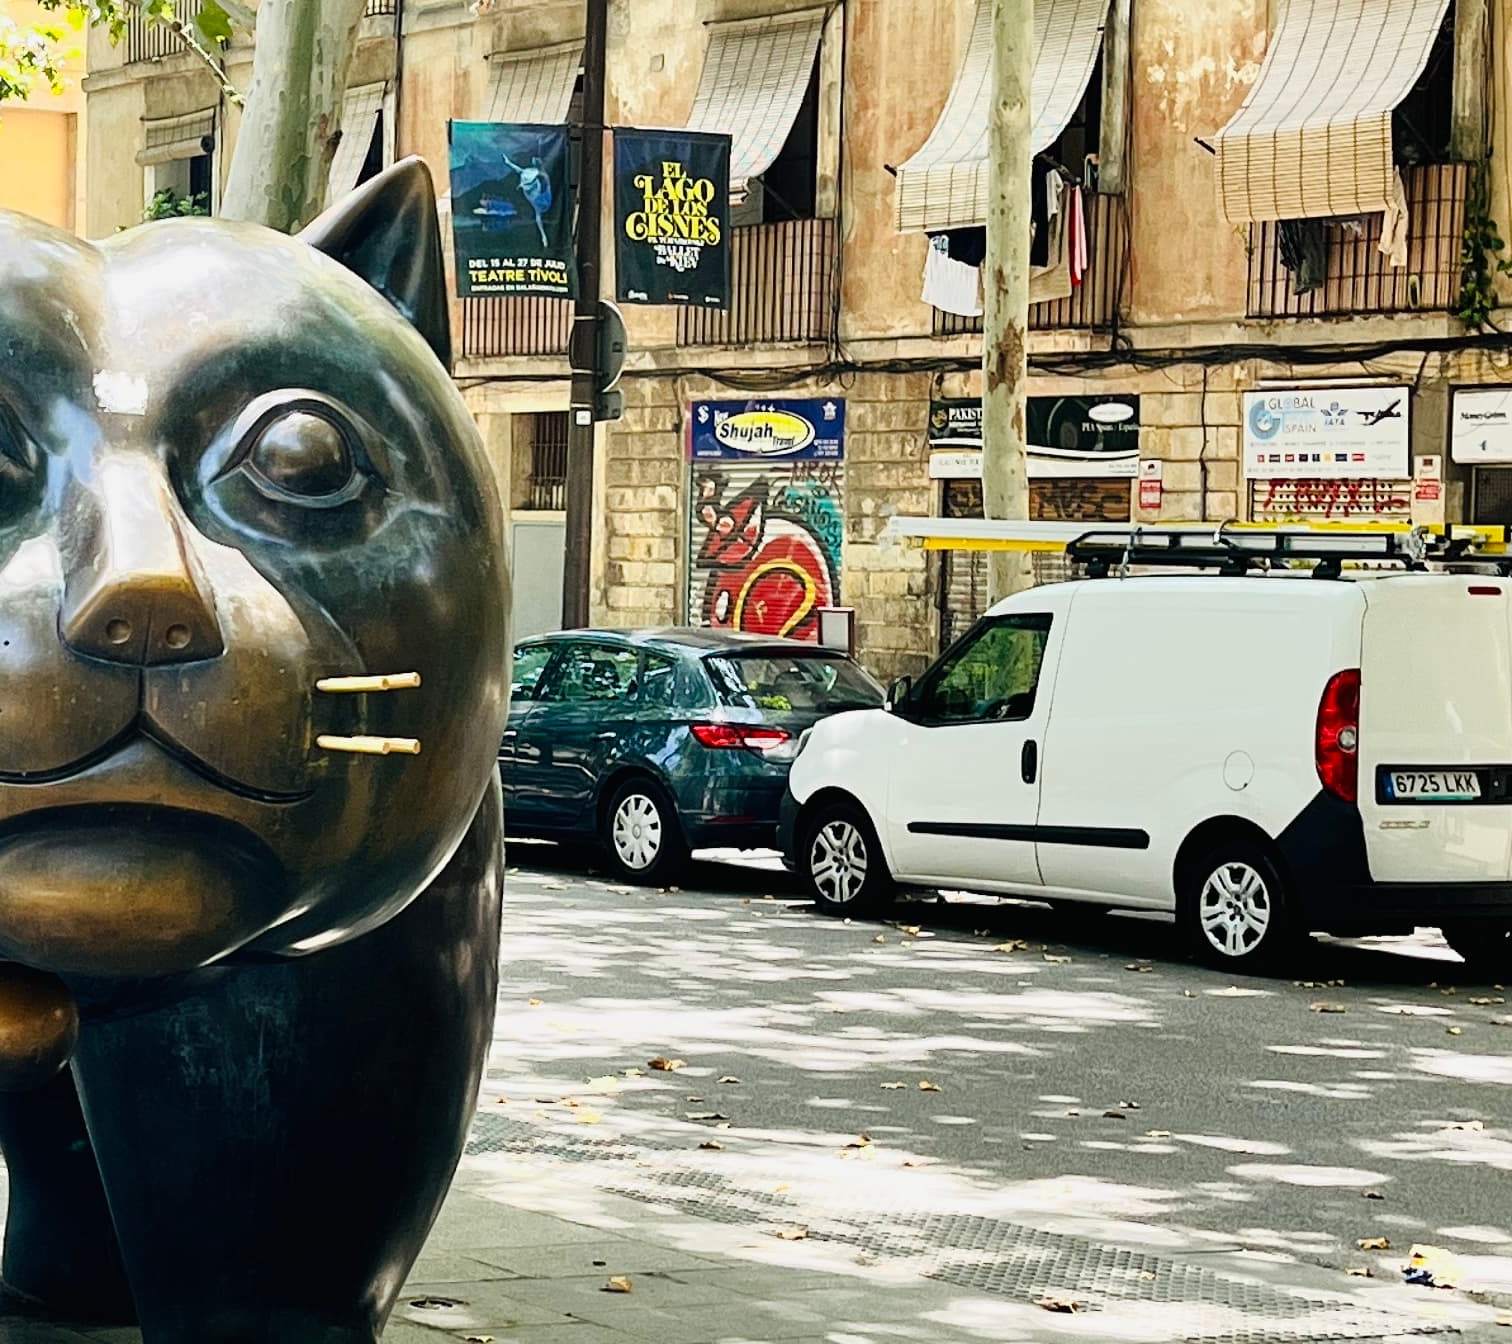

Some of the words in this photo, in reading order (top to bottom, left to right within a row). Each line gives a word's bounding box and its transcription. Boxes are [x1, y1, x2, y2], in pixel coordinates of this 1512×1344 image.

[662, 161, 687, 179] EL
[633, 174, 715, 204] LAGO
[644, 197, 669, 214] DE
[672, 197, 708, 217] LOS
[625, 212, 721, 246] CISNES
[468, 259, 488, 269] DEL
[502, 258, 515, 268] AL
[468, 269, 525, 283] TEATRE
[948, 407, 982, 420] PAKIST
[719, 422, 773, 441] Shujah
[1395, 774, 1440, 793] 6725
[1443, 774, 1476, 793] LKK
